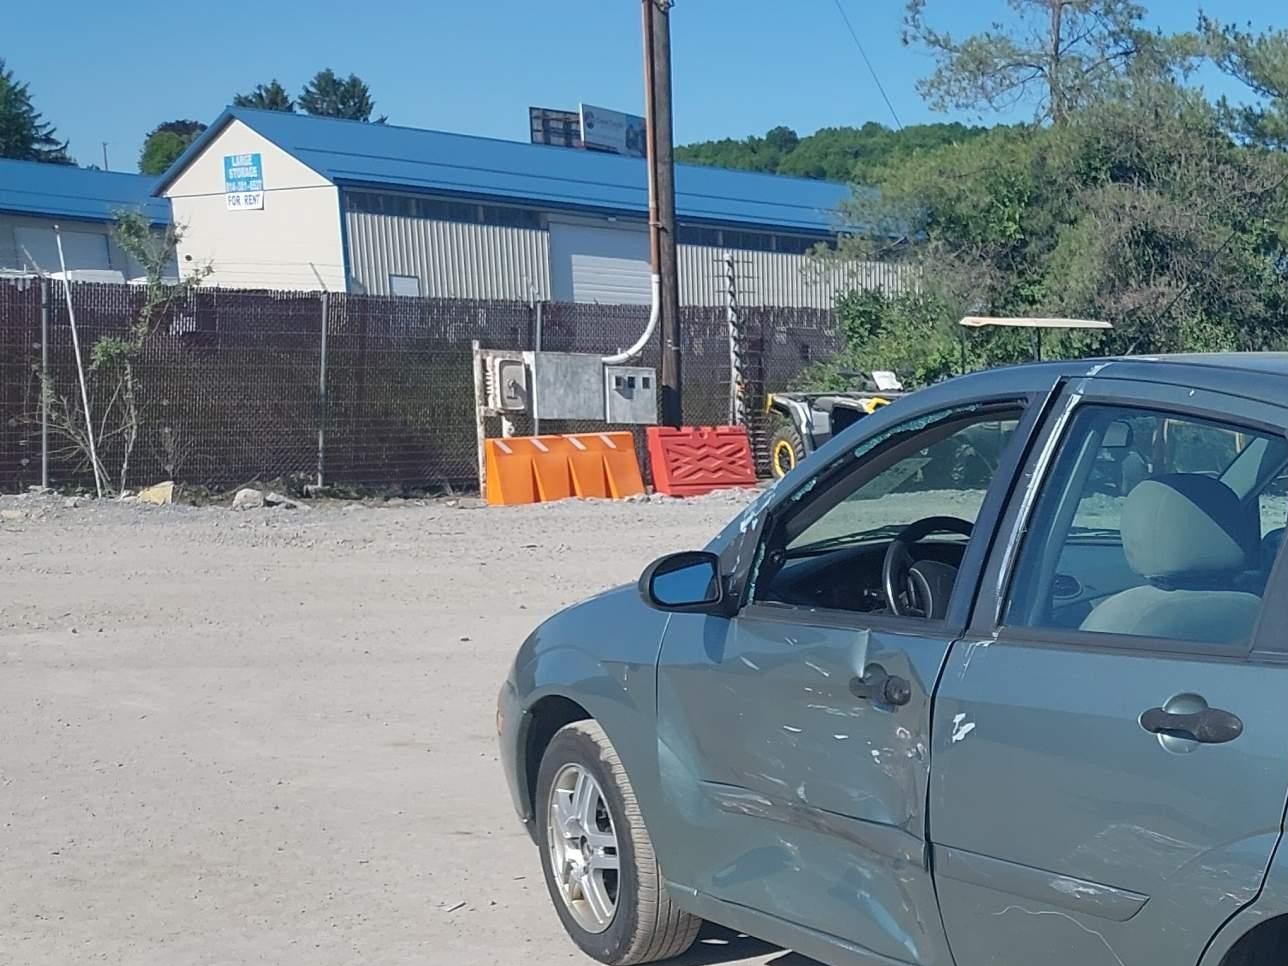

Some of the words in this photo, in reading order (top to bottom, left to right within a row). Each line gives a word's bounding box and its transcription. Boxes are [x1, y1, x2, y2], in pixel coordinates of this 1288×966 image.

[229, 167, 258, 179] STORAGE
[228, 195, 241, 206] FOR
[244, 194, 260, 205] RENT
